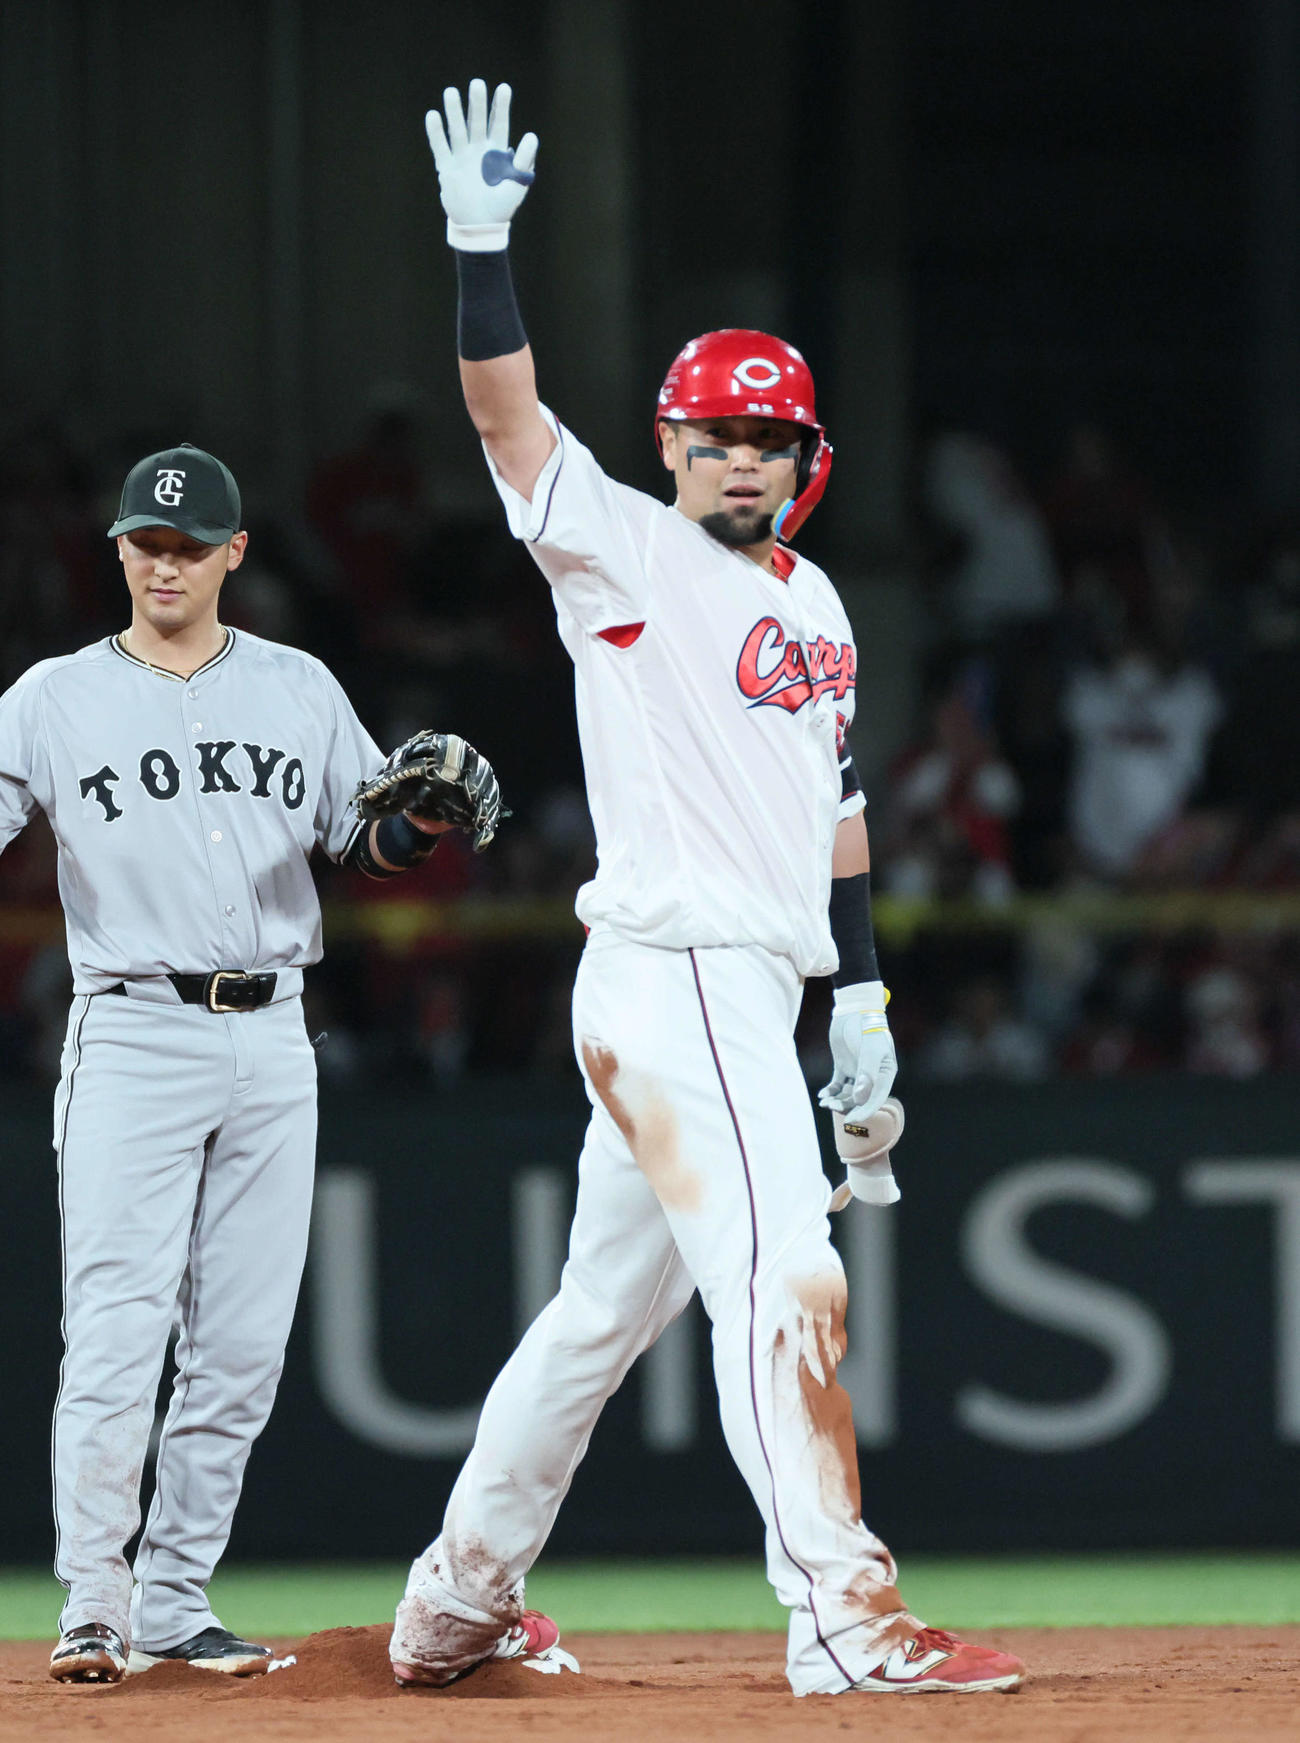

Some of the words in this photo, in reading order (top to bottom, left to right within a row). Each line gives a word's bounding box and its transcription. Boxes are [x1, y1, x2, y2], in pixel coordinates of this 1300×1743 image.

[733, 357, 781, 389] C
[736, 615, 857, 709] Carp
[78, 739, 307, 823] TOKYO
